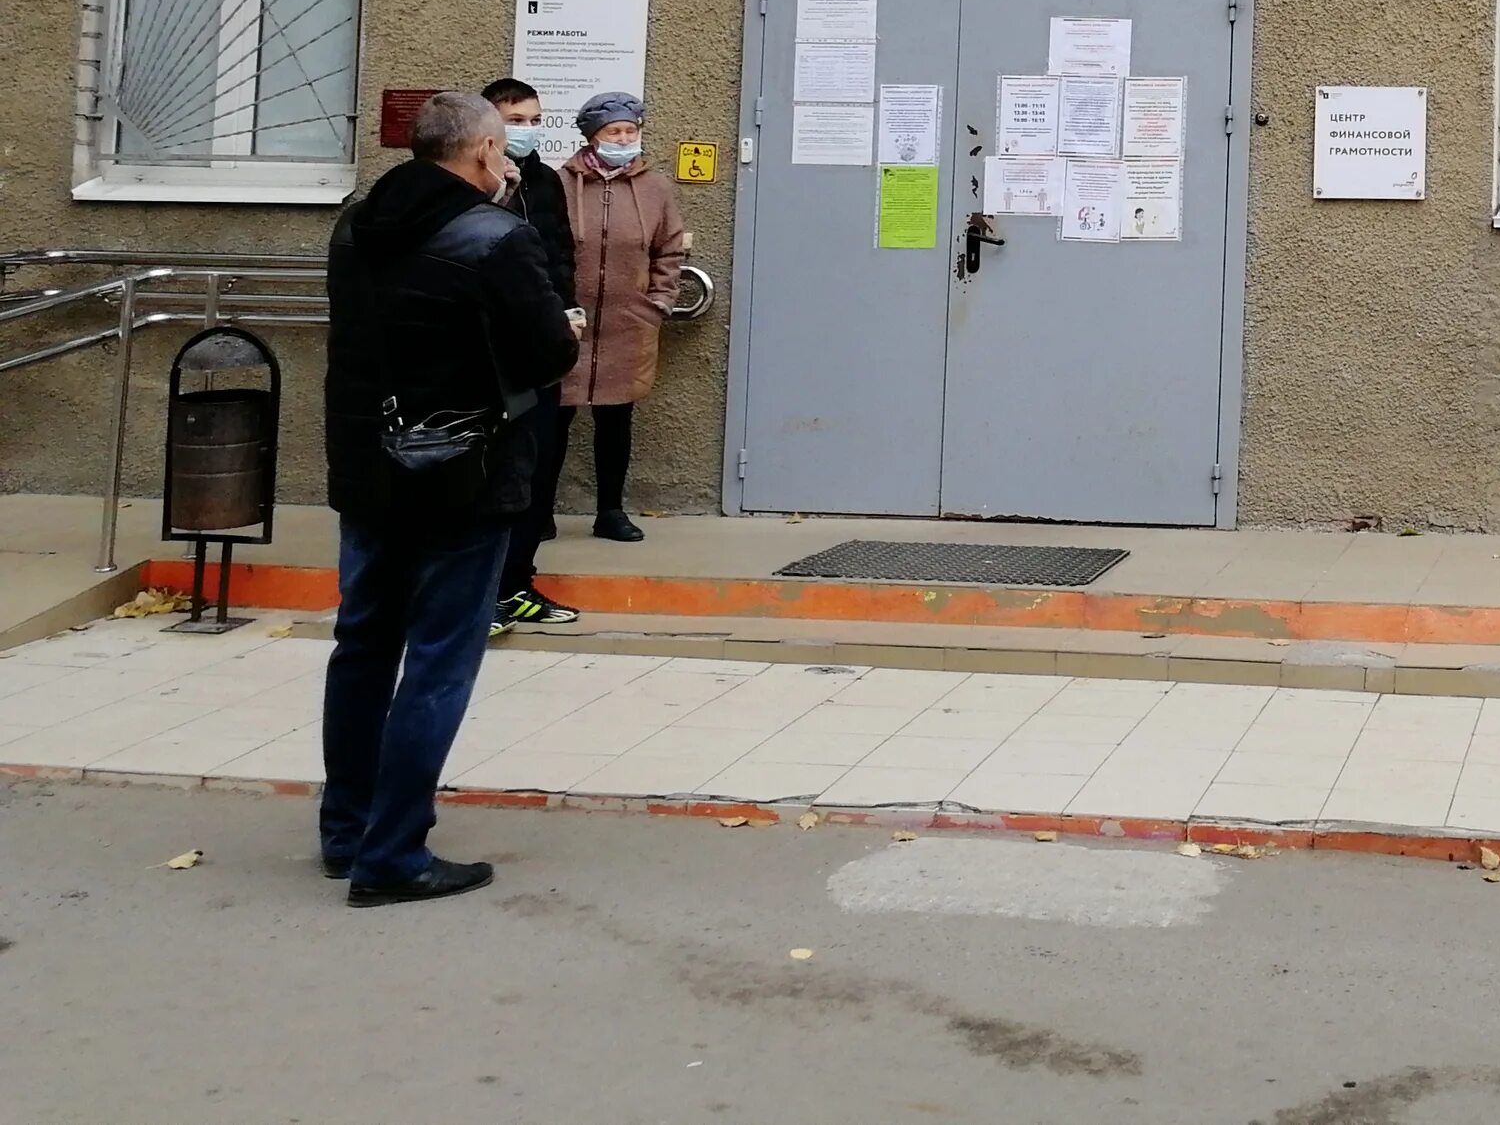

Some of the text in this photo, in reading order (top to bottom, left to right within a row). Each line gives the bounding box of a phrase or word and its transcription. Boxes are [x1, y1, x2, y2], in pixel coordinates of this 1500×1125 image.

[527, 29, 554, 37] РЕЖИМ
[1330, 113, 1366, 123] ЦЕНТР
[1329, 129, 1411, 140] ФИНАНСОВОЙ
[1329, 147, 1413, 157] ГРАМОТНОСТИ
